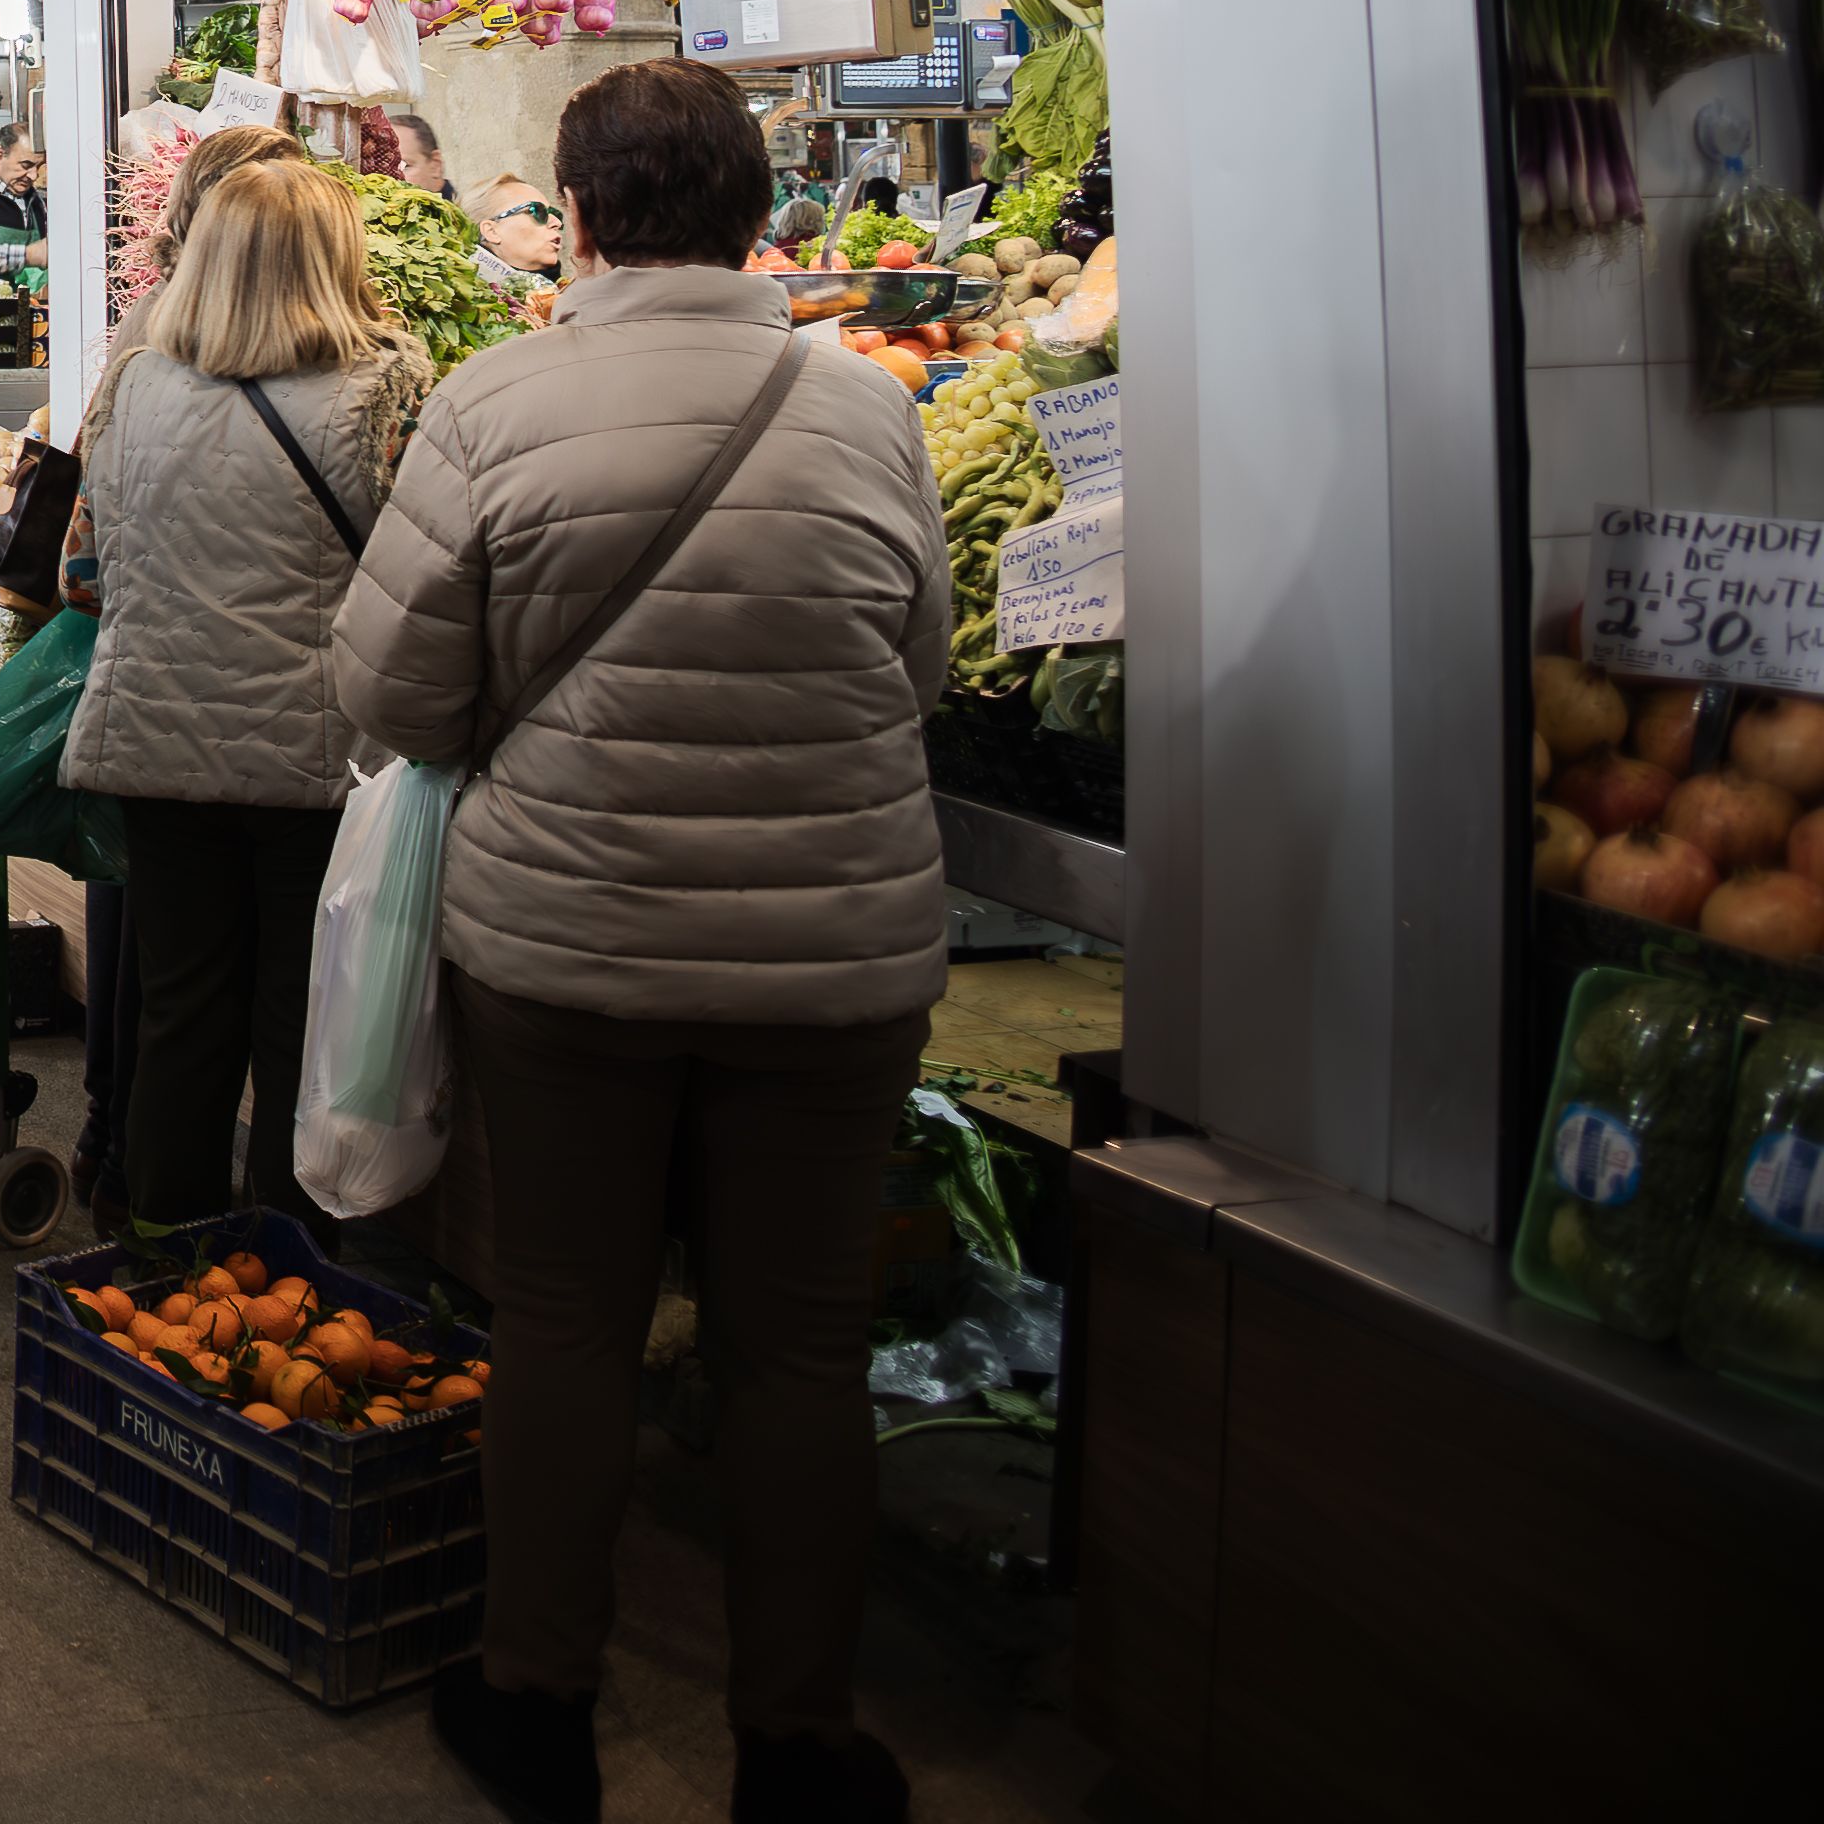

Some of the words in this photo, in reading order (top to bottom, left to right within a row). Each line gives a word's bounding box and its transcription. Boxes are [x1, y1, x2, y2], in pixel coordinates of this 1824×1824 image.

[212, 82, 228, 110] 2
[227, 89, 269, 112] MANOJOS
[1048, 431, 1060, 451] 1
[1062, 417, 1116, 446] Manojo
[1058, 458, 1072, 475] 2
[1601, 508, 1822, 558] GRANADA
[1683, 546, 1731, 572] DE
[1000, 616, 1009, 634] 2
[1055, 602, 1066, 617] 2
[1091, 622, 1105, 637] €
[121, 1399, 224, 1487] FRUNEXA
